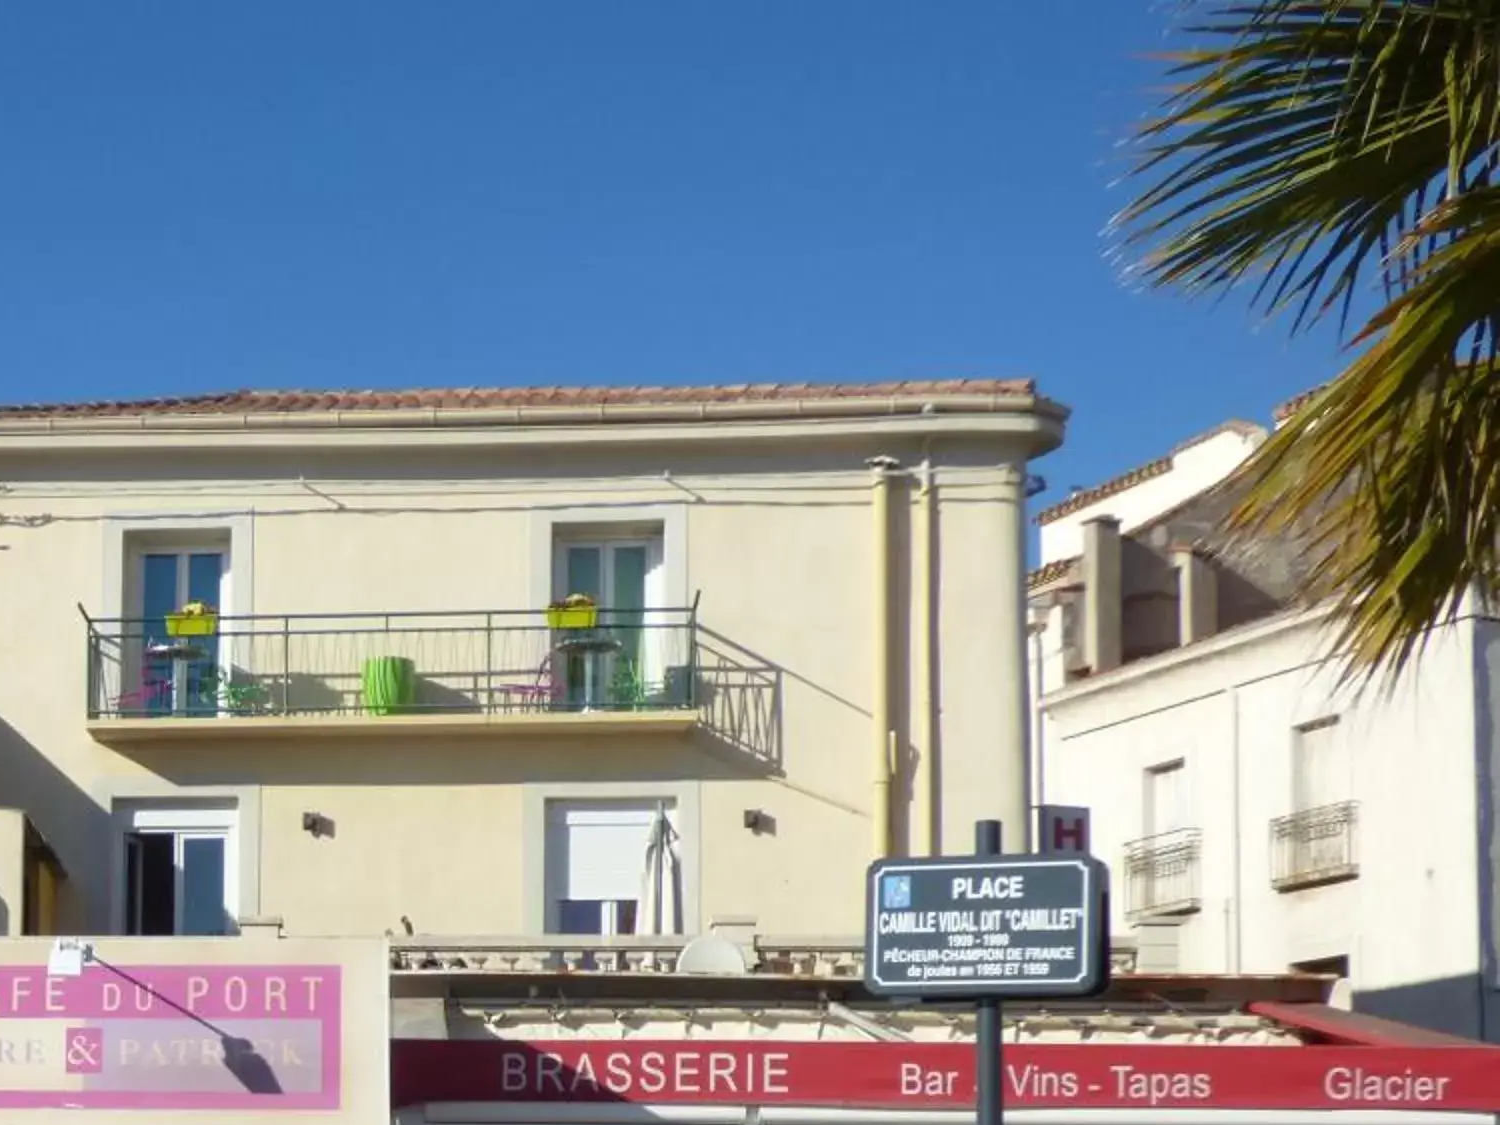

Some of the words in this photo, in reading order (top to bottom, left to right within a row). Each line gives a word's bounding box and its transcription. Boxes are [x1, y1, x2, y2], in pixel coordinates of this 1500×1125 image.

[1054, 816, 1085, 852] H
[952, 876, 1024, 899] PLACE
[880, 911, 936, 934] CAMILLE
[938, 910, 978, 932] VIDAL
[980, 910, 1002, 931] DIT
[907, 964, 921, 976] de
[1006, 948, 1023, 960] DE
[1025, 947, 1075, 960] FRANCE
[102, 983, 153, 1011] DU
[187, 976, 323, 1011] PORT
[67, 1035, 100, 1065] &
[501, 1052, 789, 1094] BRASSERIE
[901, 1063, 959, 1096] Bar
[1006, 1064, 1079, 1098] Vins
[1110, 1065, 1212, 1105] Tapas
[1323, 1066, 1451, 1101] Glacier
